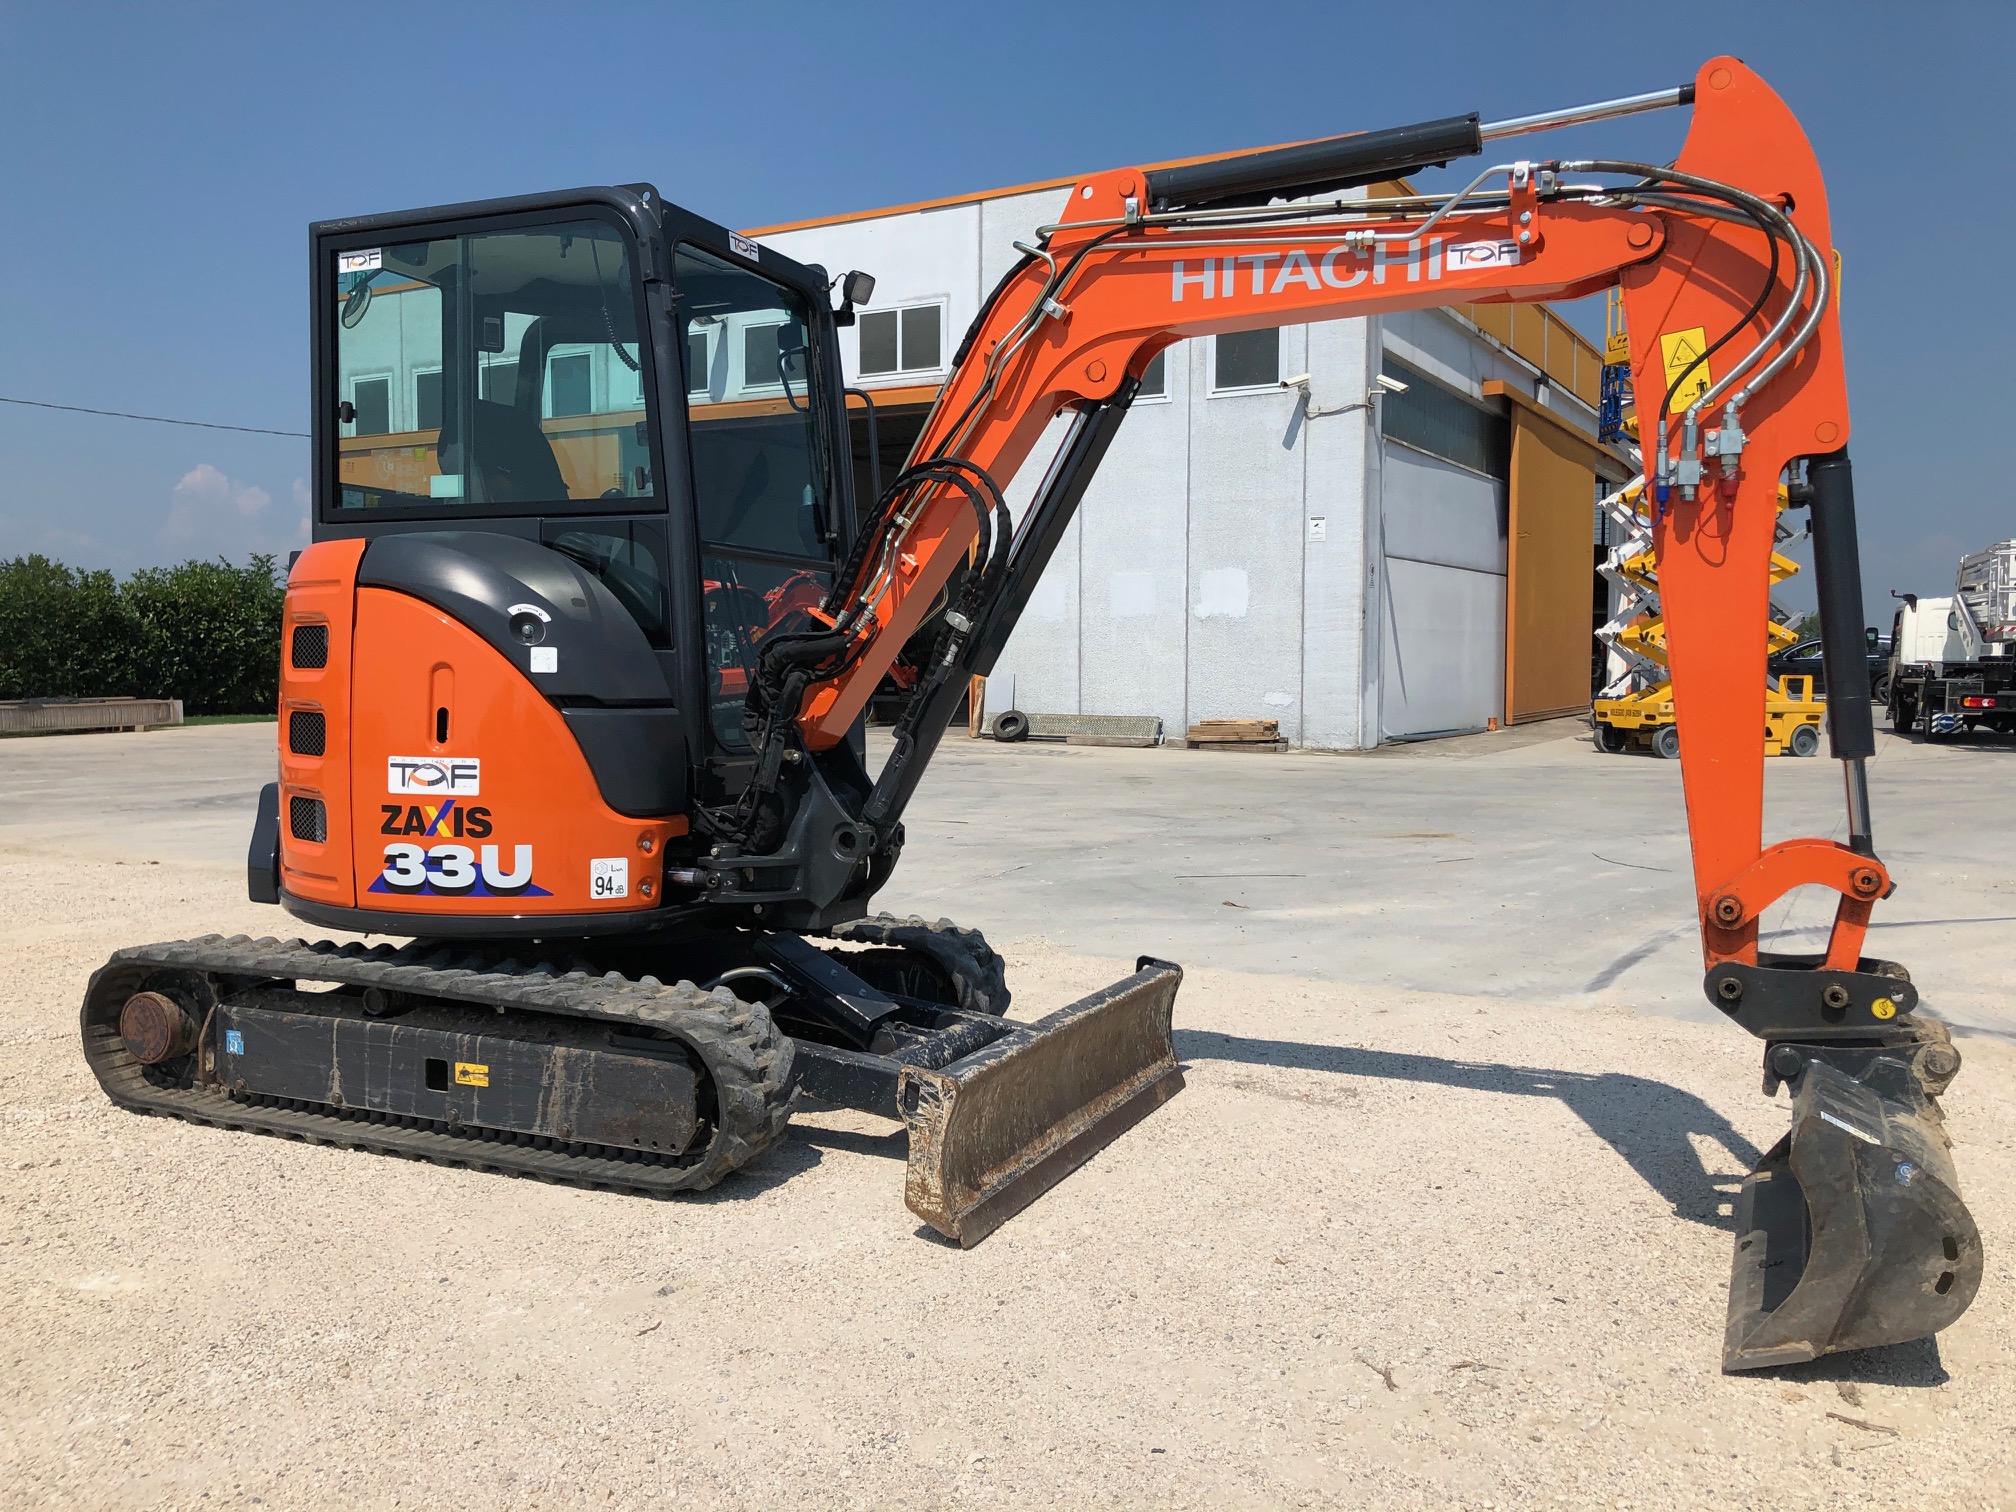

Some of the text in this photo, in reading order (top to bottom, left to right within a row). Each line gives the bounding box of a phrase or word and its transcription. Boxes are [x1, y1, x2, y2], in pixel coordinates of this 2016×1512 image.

[731, 236, 757, 255] TOF
[1450, 243, 1518, 265] TOF
[341, 252, 380, 269] TOF
[1171, 236, 1442, 302] HITACHI
[389, 763, 478, 789] TOF
[381, 799, 493, 838] ZAXIS
[383, 843, 533, 895] 33U
[595, 876, 613, 895] 94
